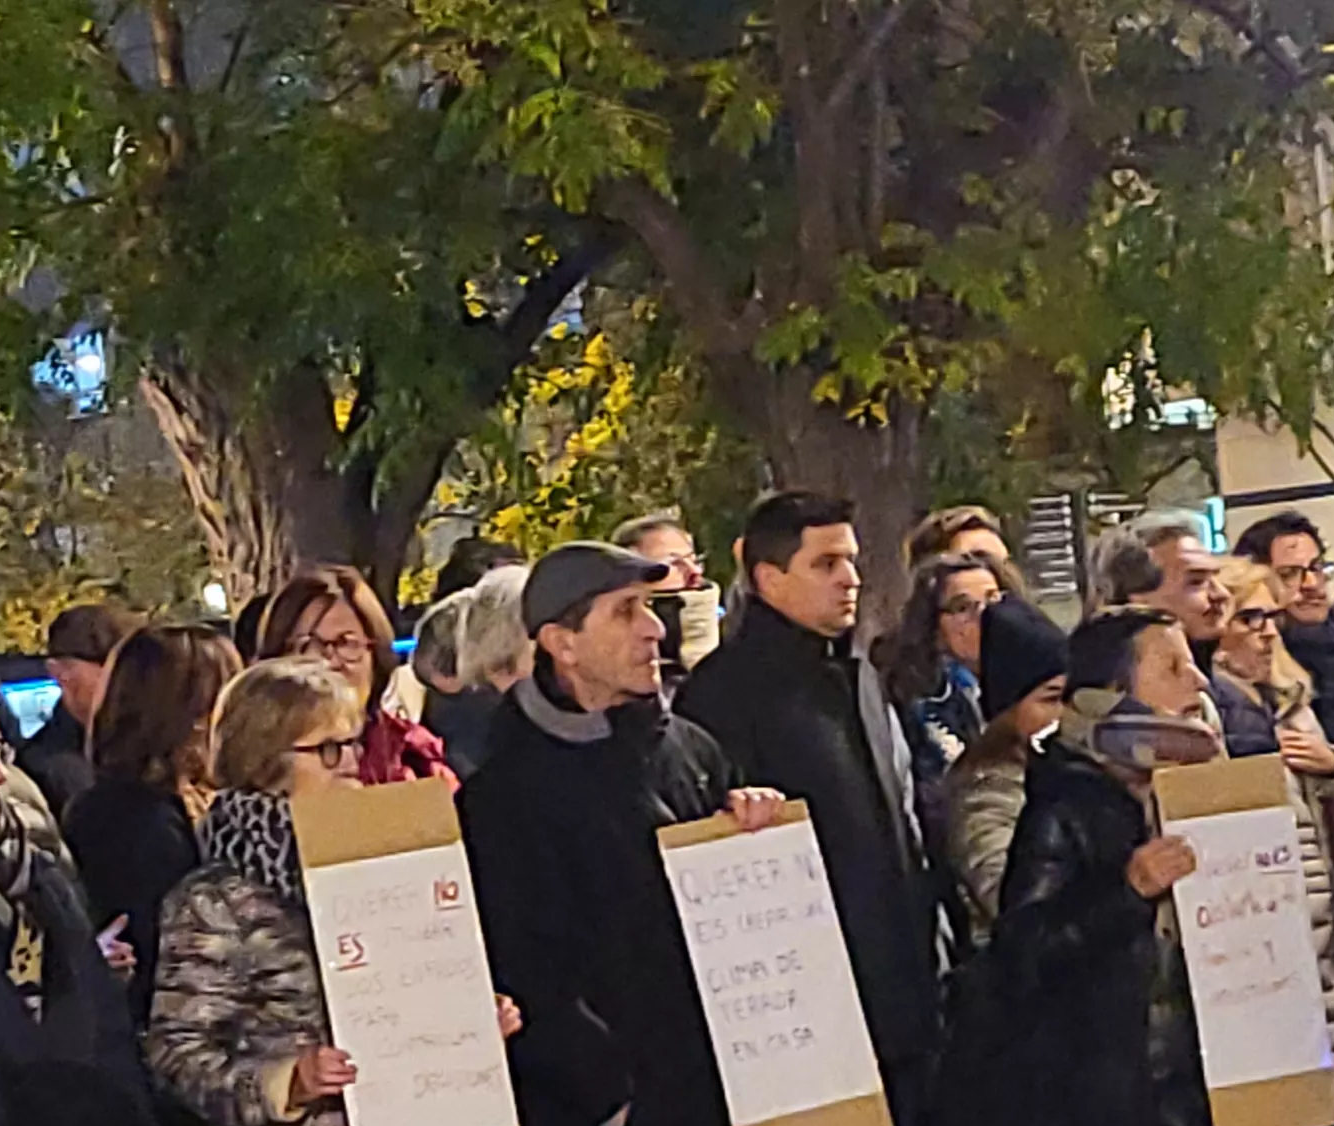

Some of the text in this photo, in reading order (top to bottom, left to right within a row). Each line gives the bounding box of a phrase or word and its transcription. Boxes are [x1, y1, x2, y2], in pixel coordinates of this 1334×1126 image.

[432, 874, 460, 908] NO
[678, 857, 785, 907] QUERER
[694, 917, 728, 944] ES
[336, 931, 365, 963] ES
[775, 948, 803, 976] DE
[731, 1040, 760, 1062] EN
